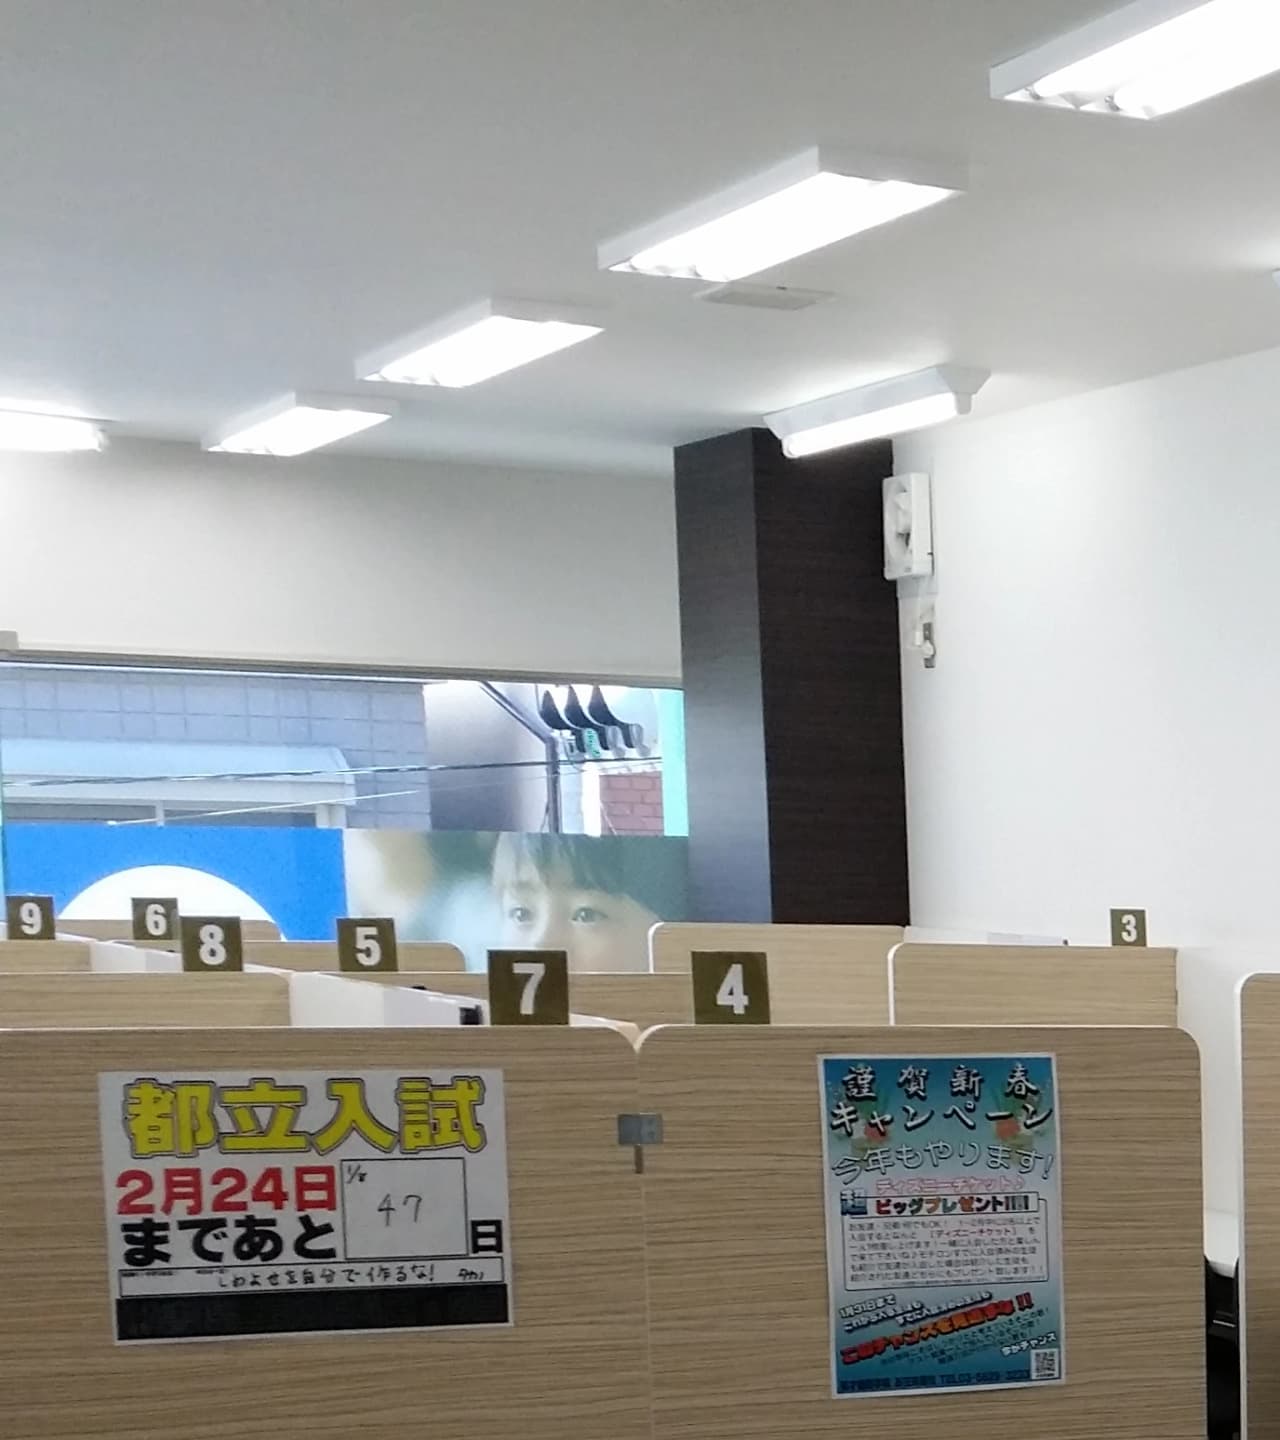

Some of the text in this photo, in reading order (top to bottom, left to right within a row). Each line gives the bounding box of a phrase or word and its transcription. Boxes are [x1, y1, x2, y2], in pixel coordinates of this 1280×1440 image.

[20, 903, 42, 934] 9
[145, 904, 167, 936] 6
[1120, 915, 1138, 943] 3
[199, 924, 226, 965] 8
[355, 926, 383, 967] 5
[512, 964, 546, 1015] 7
[716, 963, 750, 1015] 4
[843, 1061, 1040, 1101] 謹賀新春
[123, 1074, 487, 1158] 都立入試
[831, 1100, 1053, 1137] キャンペーン
[116, 1164, 337, 1216] 2月24日
[377, 1193, 424, 1227] 47
[120, 1213, 503, 1267] まであと 日
